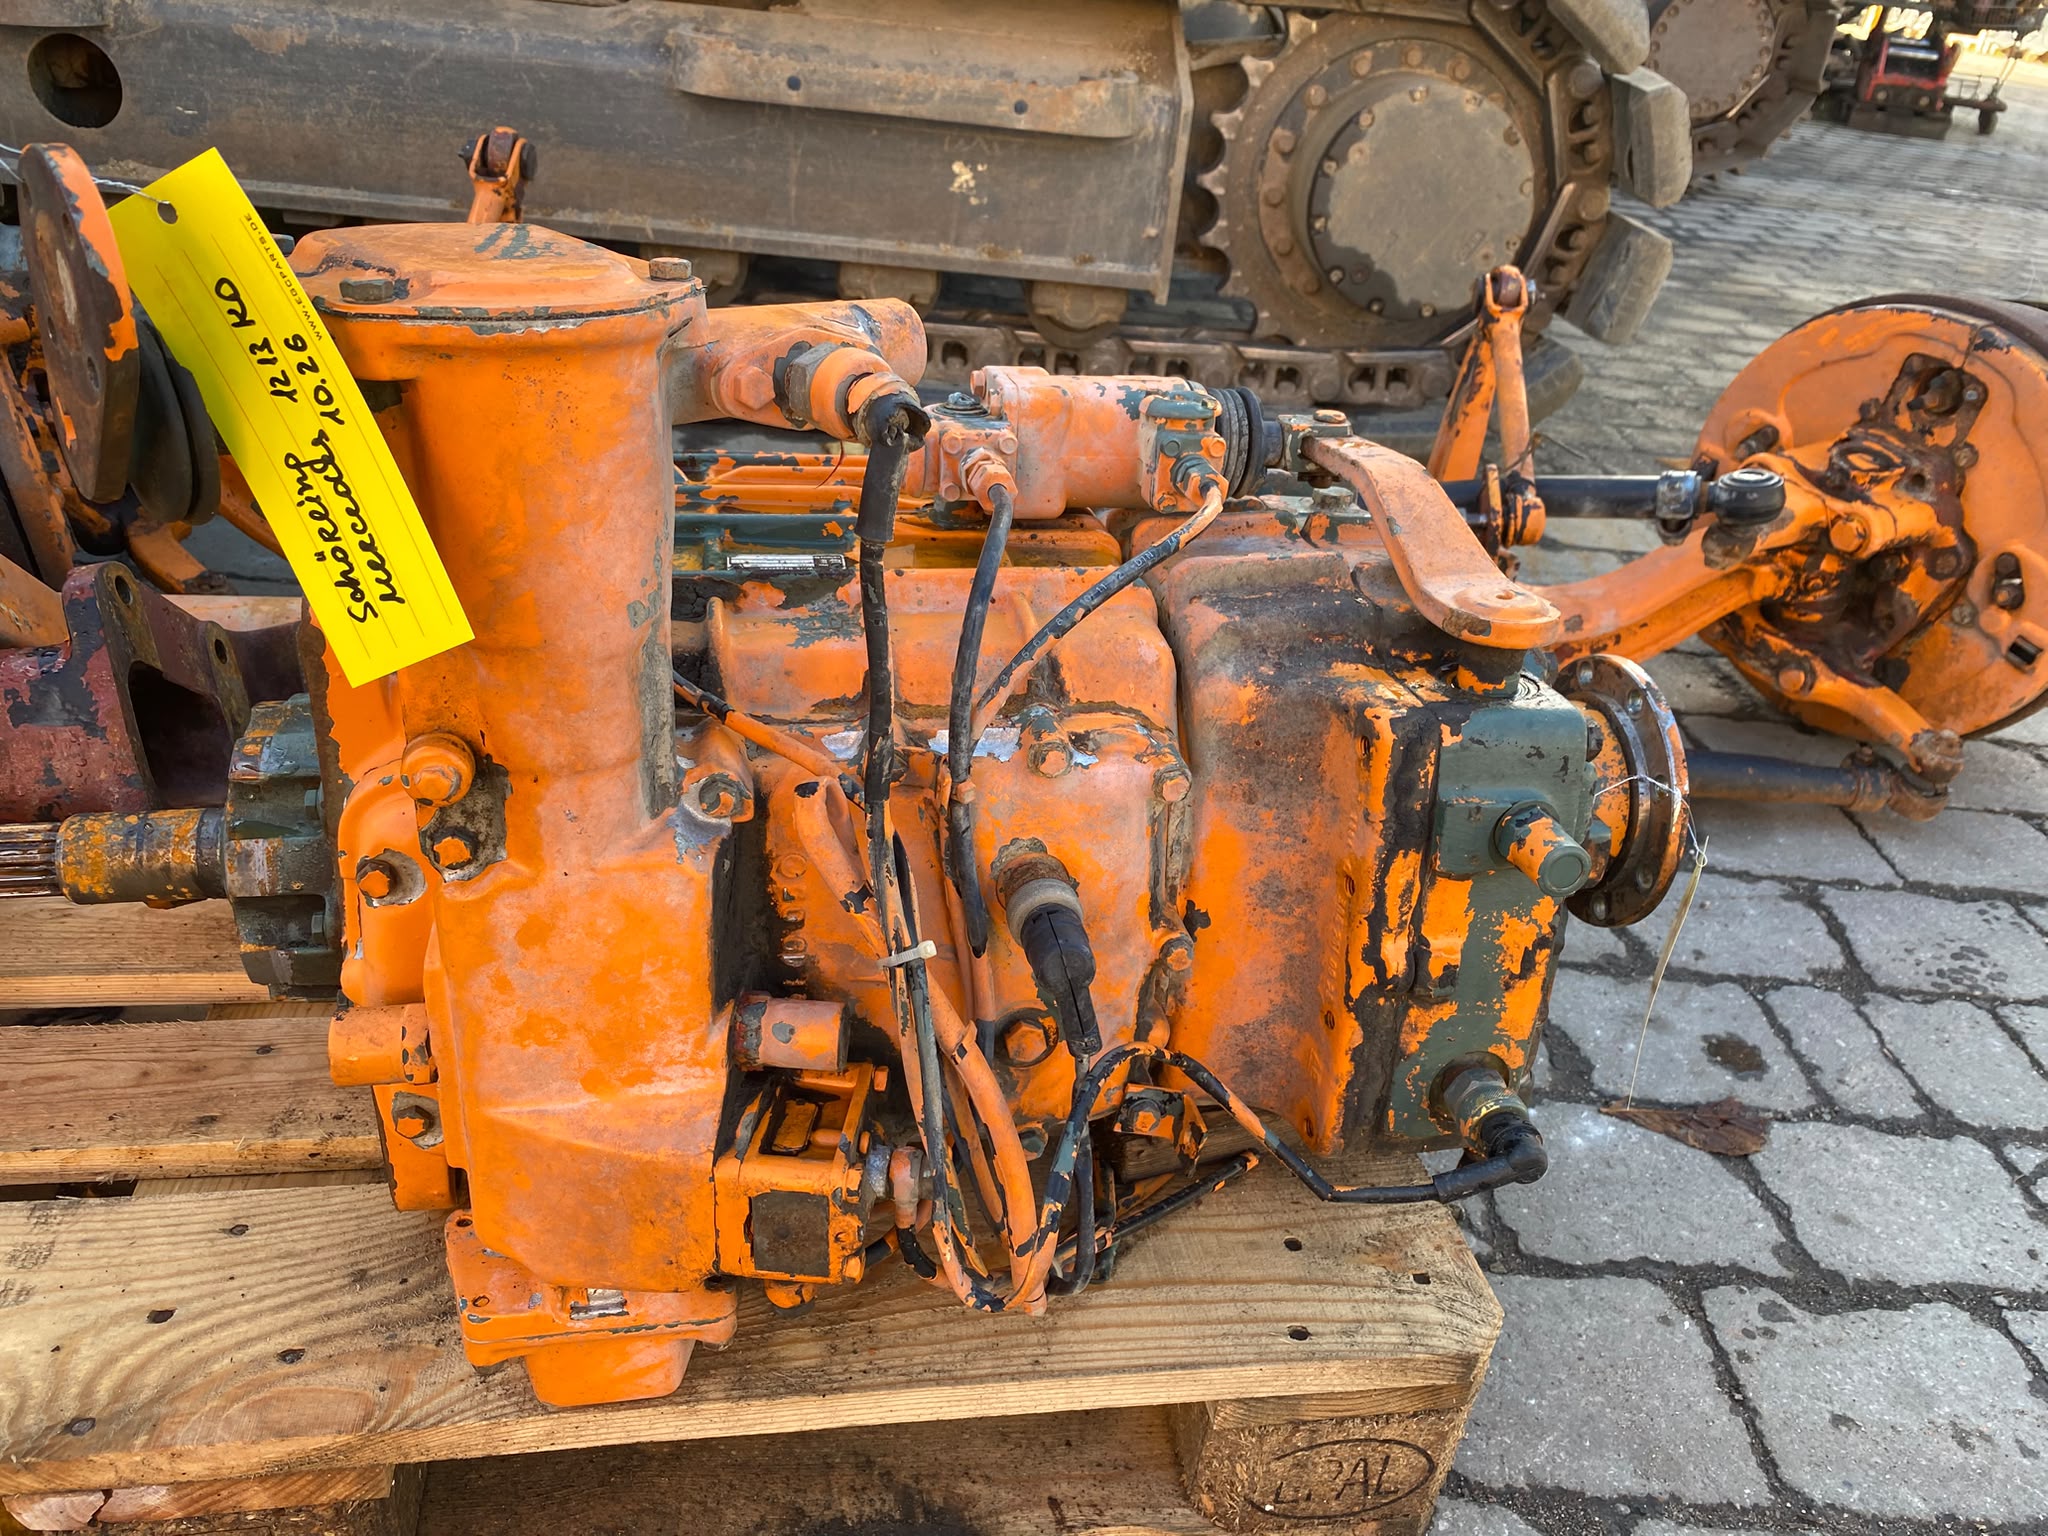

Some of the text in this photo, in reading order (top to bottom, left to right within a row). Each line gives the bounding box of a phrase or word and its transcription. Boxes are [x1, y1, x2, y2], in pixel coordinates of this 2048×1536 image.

[244, 213, 323, 342] WWW.EGCPARTS.DE
[248, 337, 298, 403] 1213
[283, 333, 345, 425] 10.26
[1021, 650, 1030, 659] 5
[1032, 639, 1041, 648] 6
[1055, 617, 1064, 626] 8
[1133, 551, 1154, 567] DIN
